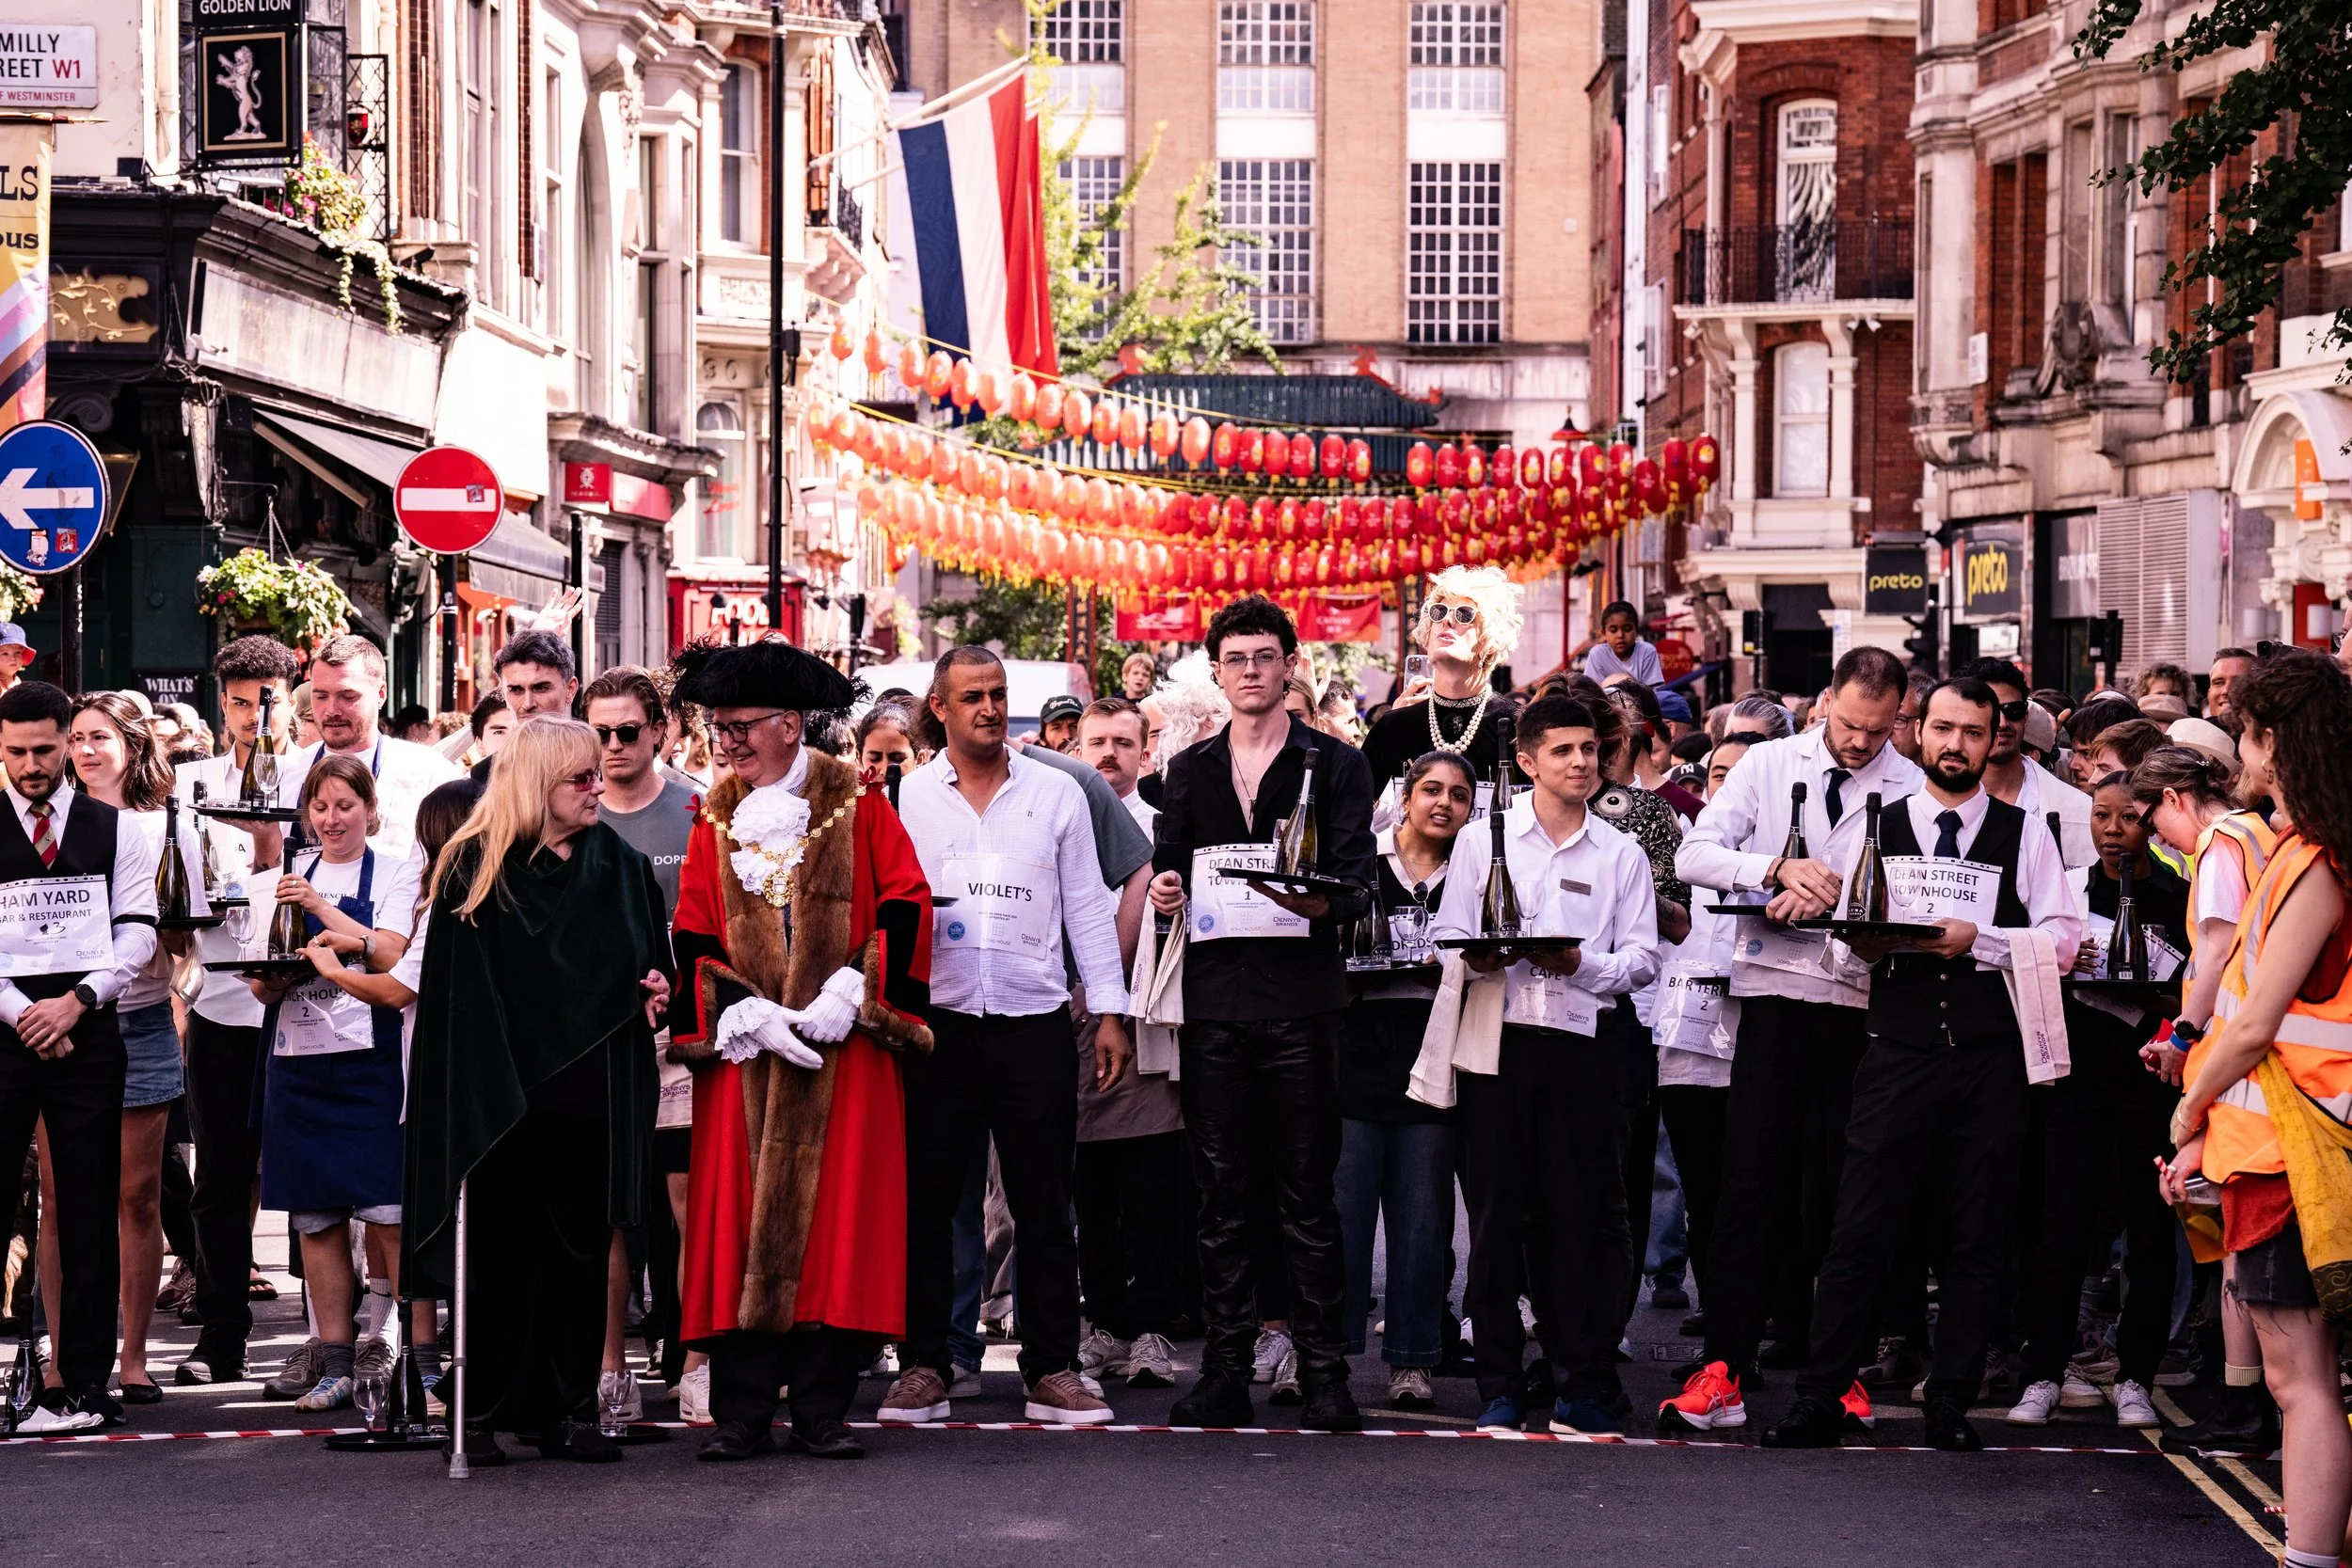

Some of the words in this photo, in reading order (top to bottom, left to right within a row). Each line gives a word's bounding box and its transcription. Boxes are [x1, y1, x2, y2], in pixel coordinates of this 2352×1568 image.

[199, 0, 254, 14] GOLDEN
[259, 0, 292, 11] LION
[0, 33, 59, 53] MILLY
[52, 59, 81, 79] W1
[8, 91, 76, 102] WESTMINSTER
[0, 166, 38, 201] LS
[1869, 572, 1924, 593] preto
[1967, 544, 2009, 607] preto
[145, 677, 194, 692] WHAT'S
[1209, 858, 1243, 870] DEAN
[1894, 869, 1927, 880] DEAN
[1931, 869, 1980, 887] STREET
[43, 889, 90, 906] YARD
[967, 882, 1033, 903] VIOLET'S
[1245, 891, 1252, 901] 1
[1926, 902, 1935, 914] 2
[0, 914, 16, 924] AR
[18, 913, 26, 922] &
[28, 909, 92, 921] RESTAURANT
[1021, 933, 1041, 944] DENNYS
[1668, 976, 1693, 991] BAR
[301, 1006, 310, 1018] 2
[1700, 1000, 1709, 1011] 2
[1566, 1010, 1590, 1022] DENNYS
[660, 1084, 691, 1093] DENNYS
